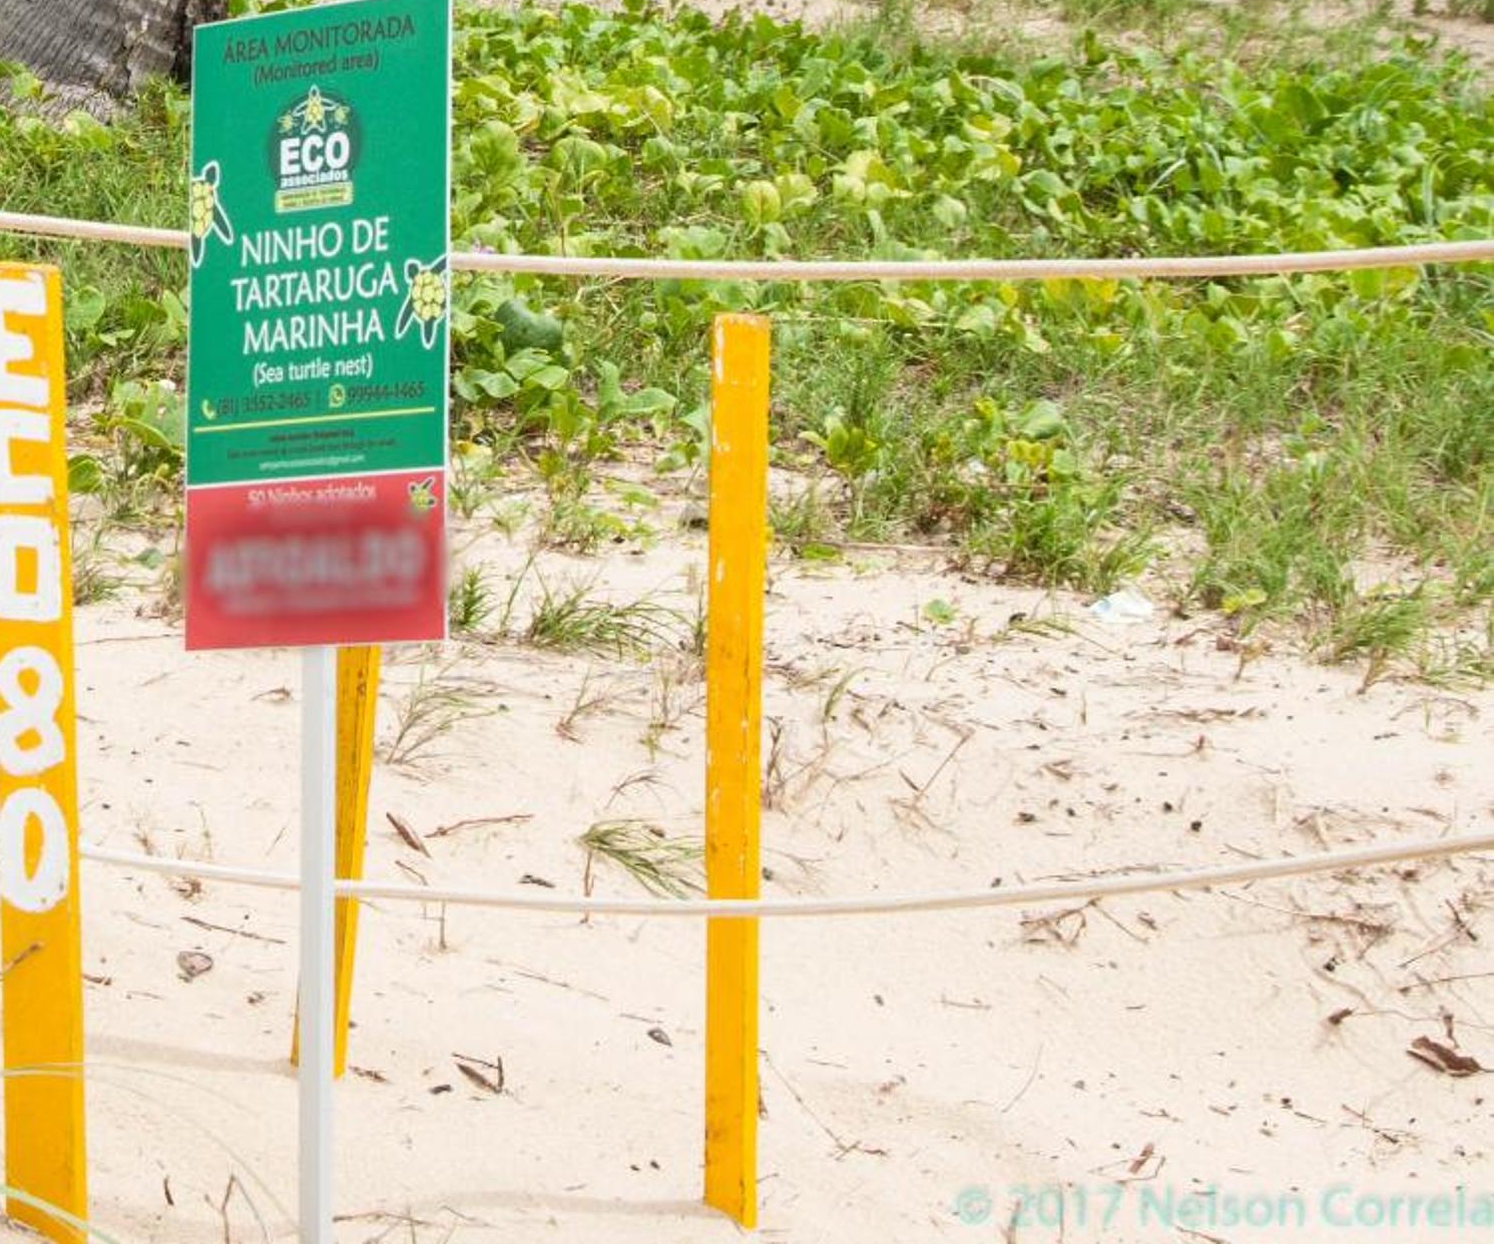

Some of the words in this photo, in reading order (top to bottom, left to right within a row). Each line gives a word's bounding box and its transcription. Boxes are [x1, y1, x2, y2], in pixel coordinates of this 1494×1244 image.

[223, 37, 268, 64] ÁREA
[275, 15, 416, 54] MONITORADA
[253, 57, 338, 86] (Monitored
[342, 53, 380, 73] area)
[279, 132, 351, 175] ECO
[279, 169, 349, 188] associados
[241, 222, 343, 267] NINHO
[352, 216, 390, 253] DE
[231, 262, 399, 311] TARTARUGA
[243, 308, 385, 355] MARINHA
[253, 362, 284, 388] (Sea
[288, 357, 331, 381] turtle
[335, 353, 373, 378] nest)
